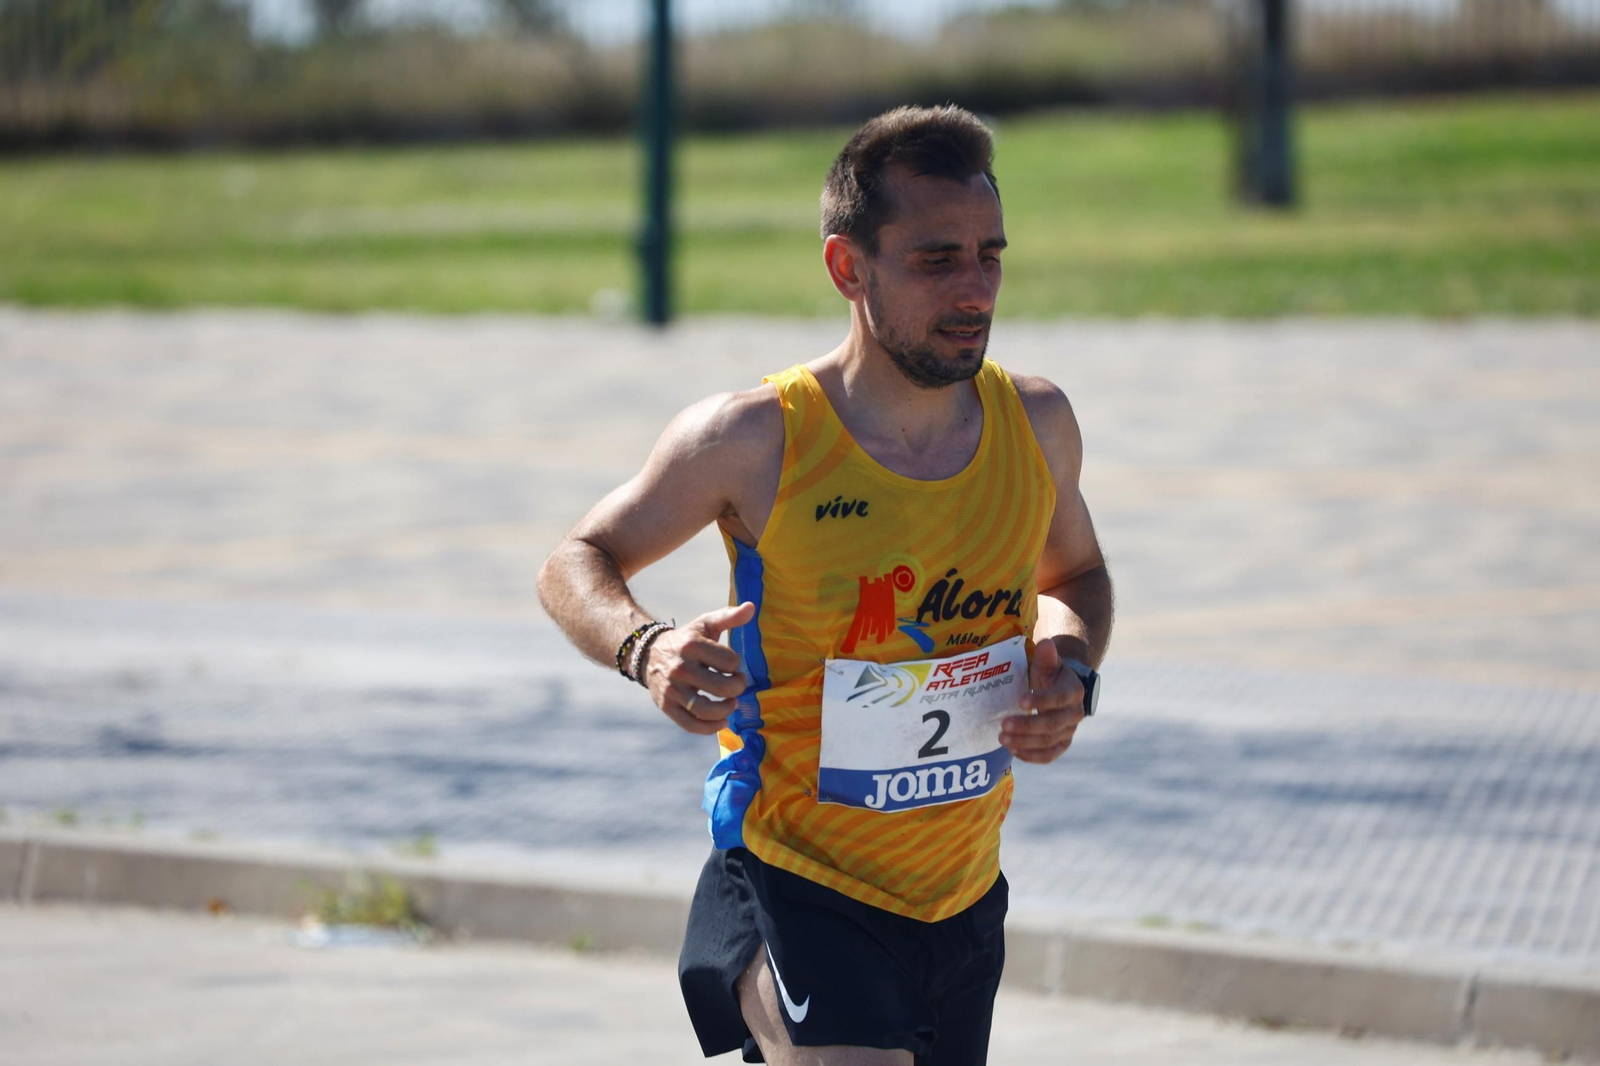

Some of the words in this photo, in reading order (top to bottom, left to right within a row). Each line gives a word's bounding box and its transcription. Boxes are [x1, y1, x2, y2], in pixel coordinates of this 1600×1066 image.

[916, 568, 1023, 624] Álora
[946, 632, 990, 646] Málag
[926, 661, 1012, 691] ATLETISMO
[932, 651, 990, 678] RFEA
[919, 690, 959, 704] RUTA
[962, 674, 1014, 698] RUNNING
[917, 709, 951, 759] 2
